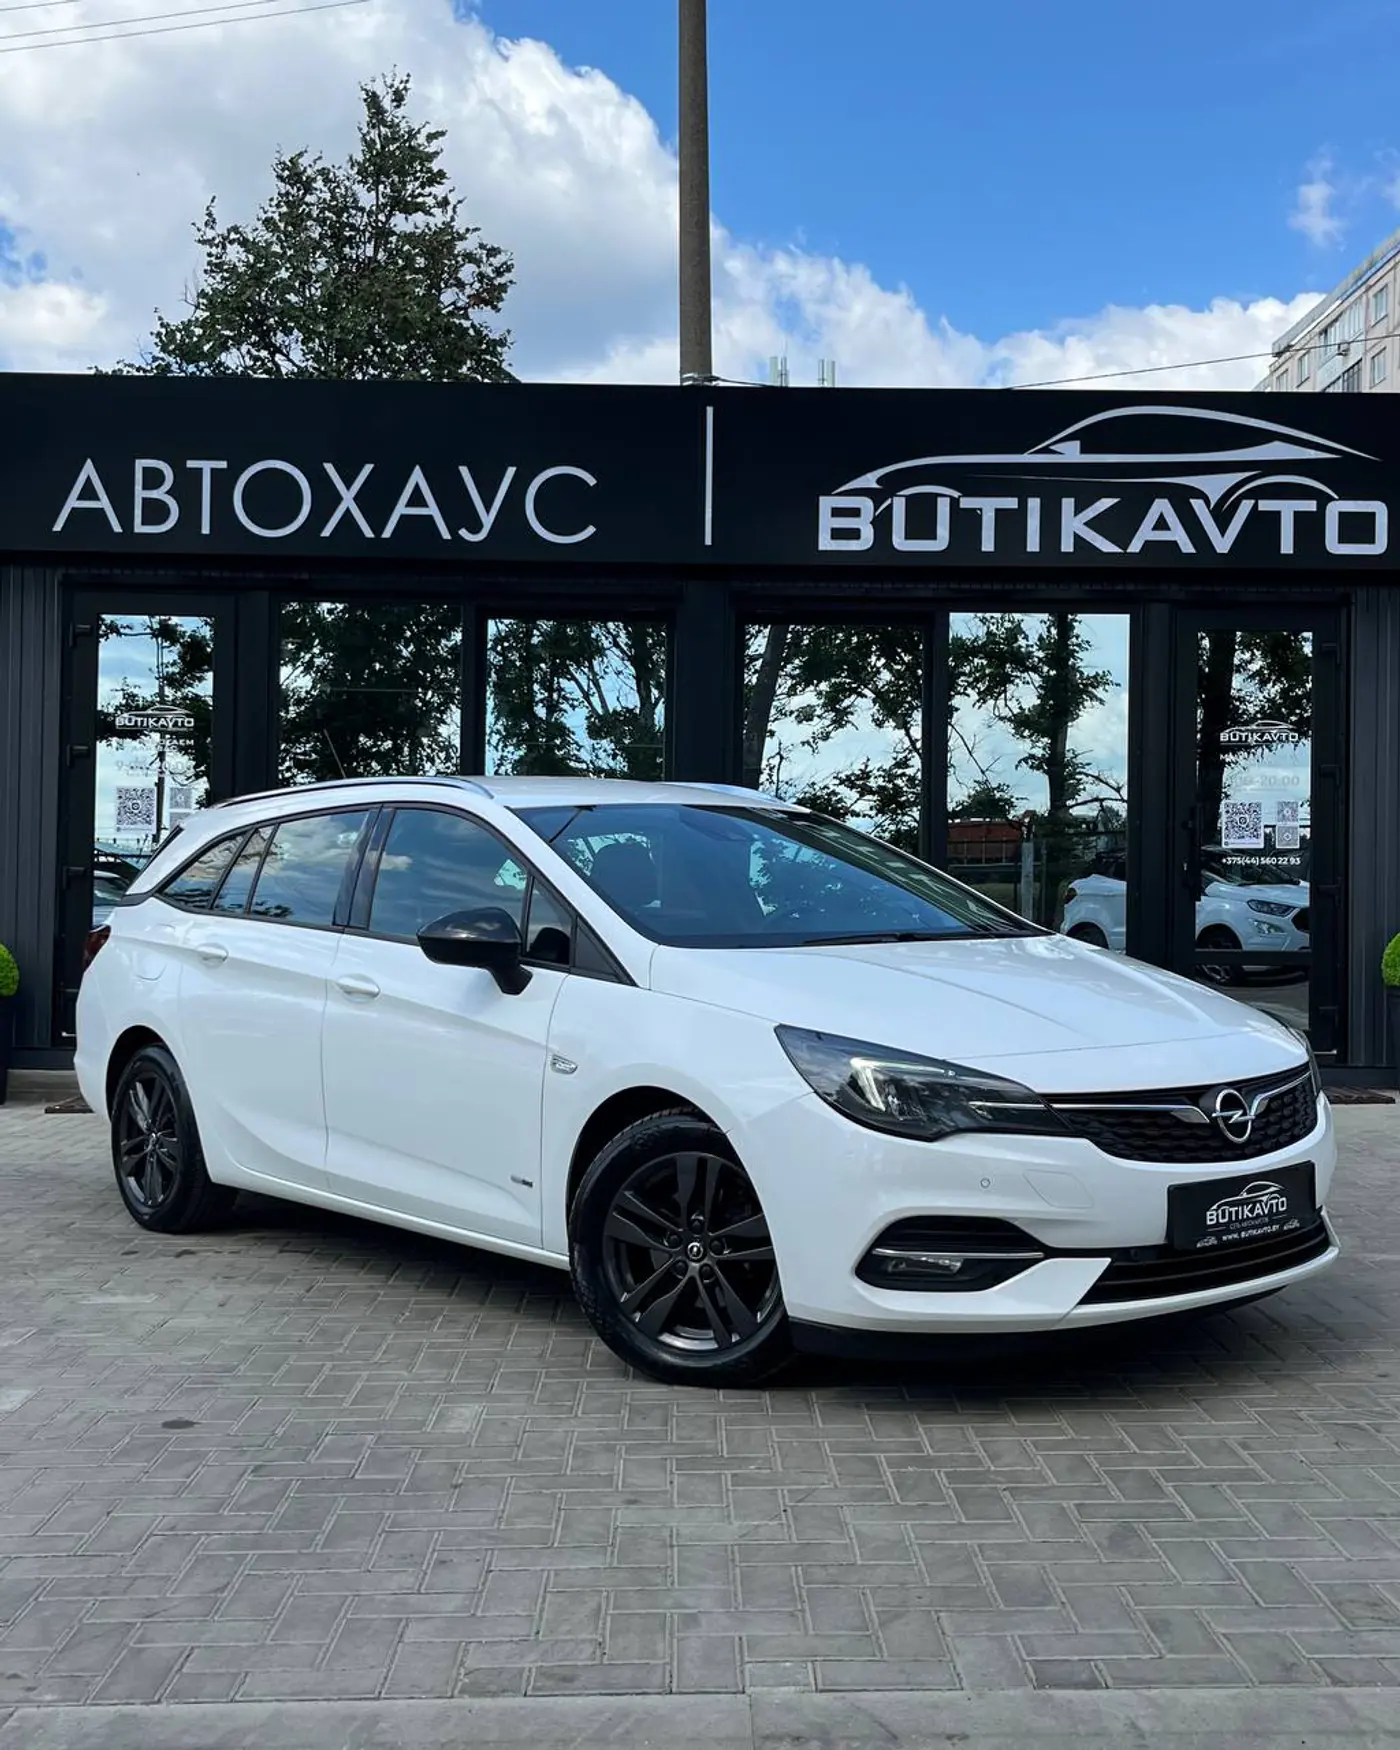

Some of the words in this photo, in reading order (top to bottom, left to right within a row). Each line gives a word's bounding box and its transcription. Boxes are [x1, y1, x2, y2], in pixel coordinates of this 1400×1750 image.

[52, 457, 599, 545] АВТОХАУС
[818, 492, 1388, 556] BUTIKAVTO
[115, 716, 195, 728] BUTIKAVTO
[1219, 731, 1299, 743] BUTIKAVTO
[1205, 1197, 1288, 1226] BUTIKAVTO
